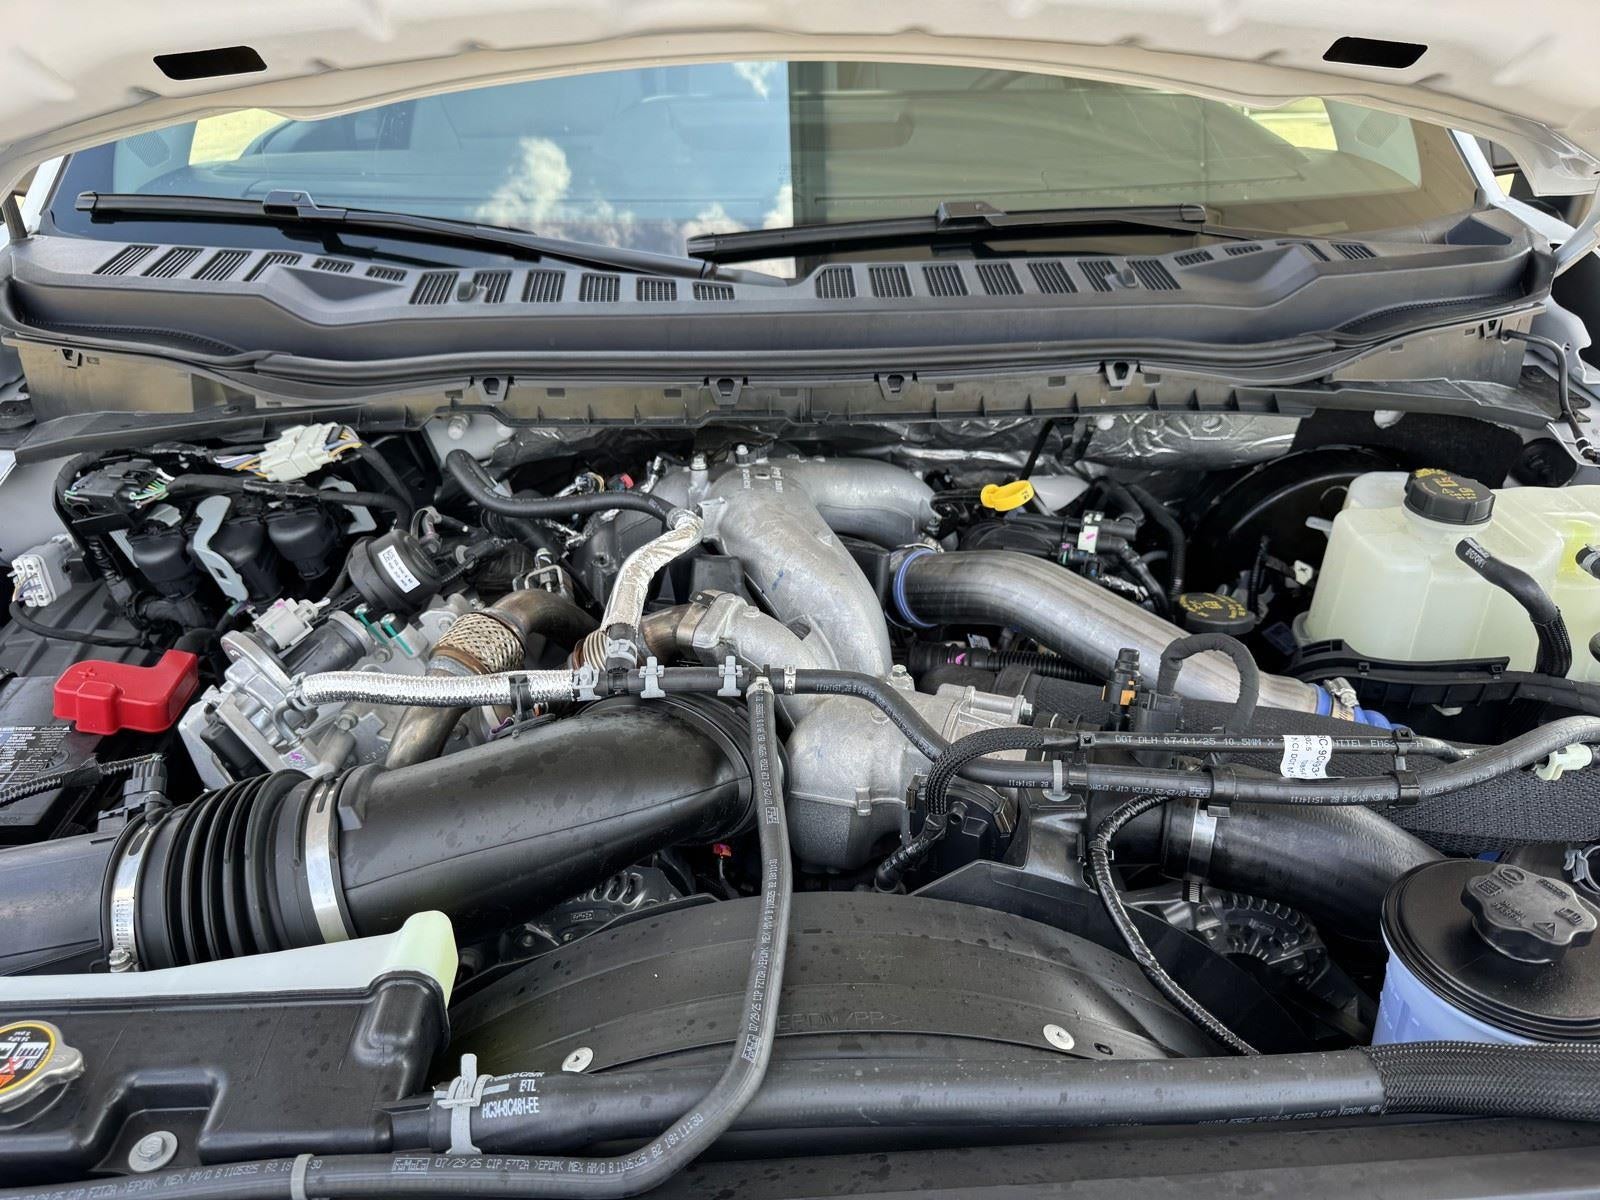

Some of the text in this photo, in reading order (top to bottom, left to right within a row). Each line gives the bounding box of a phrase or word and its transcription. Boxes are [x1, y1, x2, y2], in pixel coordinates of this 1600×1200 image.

[434, 1157, 482, 1169] 07/29/25
[486, 1158, 501, 1170] CIP
[568, 1161, 584, 1172] MEX
[664, 1112, 704, 1149] 18:11:30
